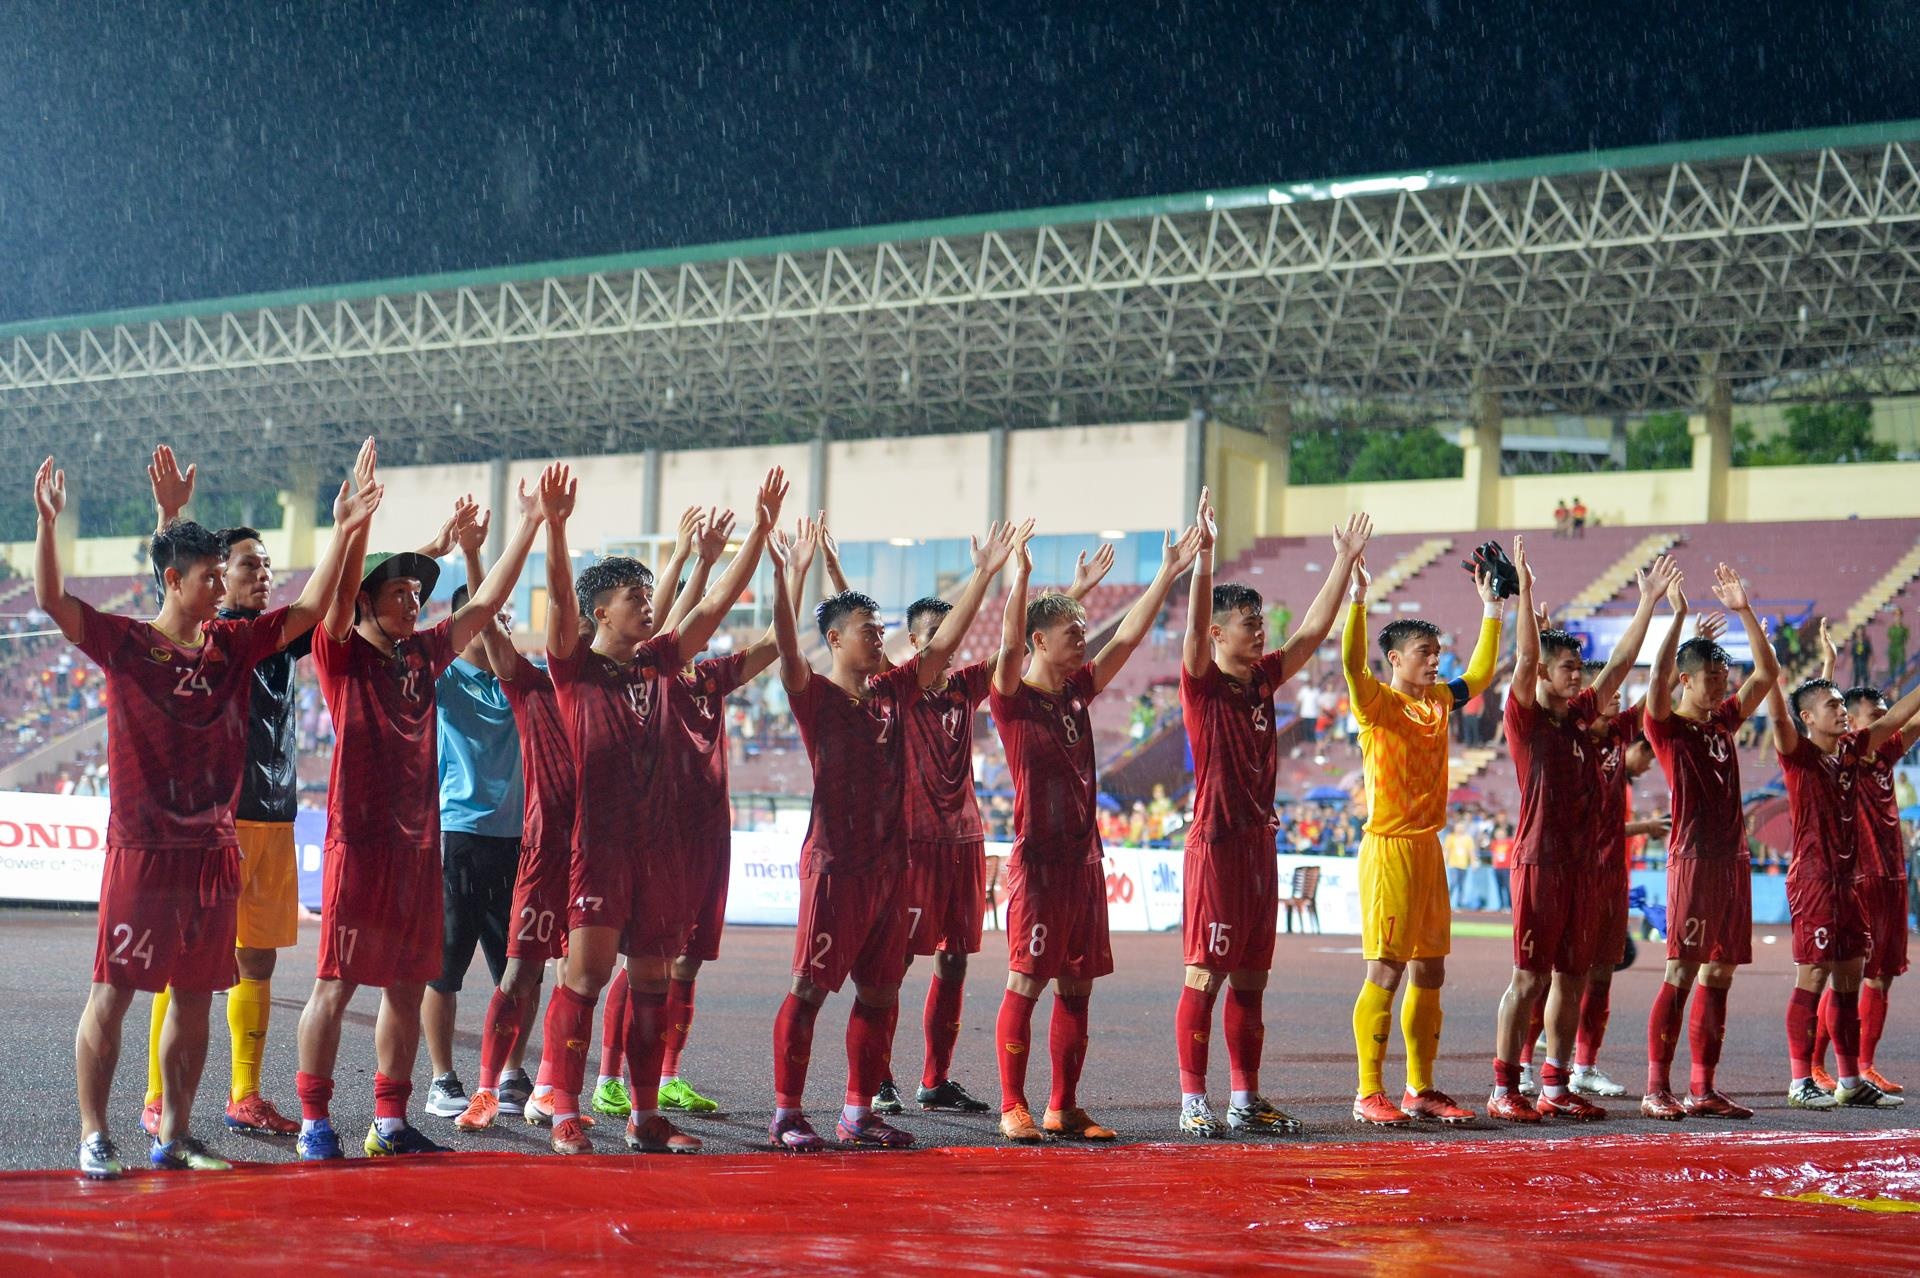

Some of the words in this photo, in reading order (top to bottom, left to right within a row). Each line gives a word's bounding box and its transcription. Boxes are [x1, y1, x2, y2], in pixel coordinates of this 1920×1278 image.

[174, 666, 212, 697] 24
[1063, 715, 1079, 743] 8
[1573, 739, 1585, 762] 4
[0, 821, 105, 850] OND
[518, 907, 555, 943] 20
[1029, 923, 1048, 956] 8
[1208, 922, 1233, 956] 15
[1683, 917, 1707, 947] 21
[109, 924, 154, 970] 24
[811, 933, 832, 969] 2
[1520, 929, 1535, 959] 4
